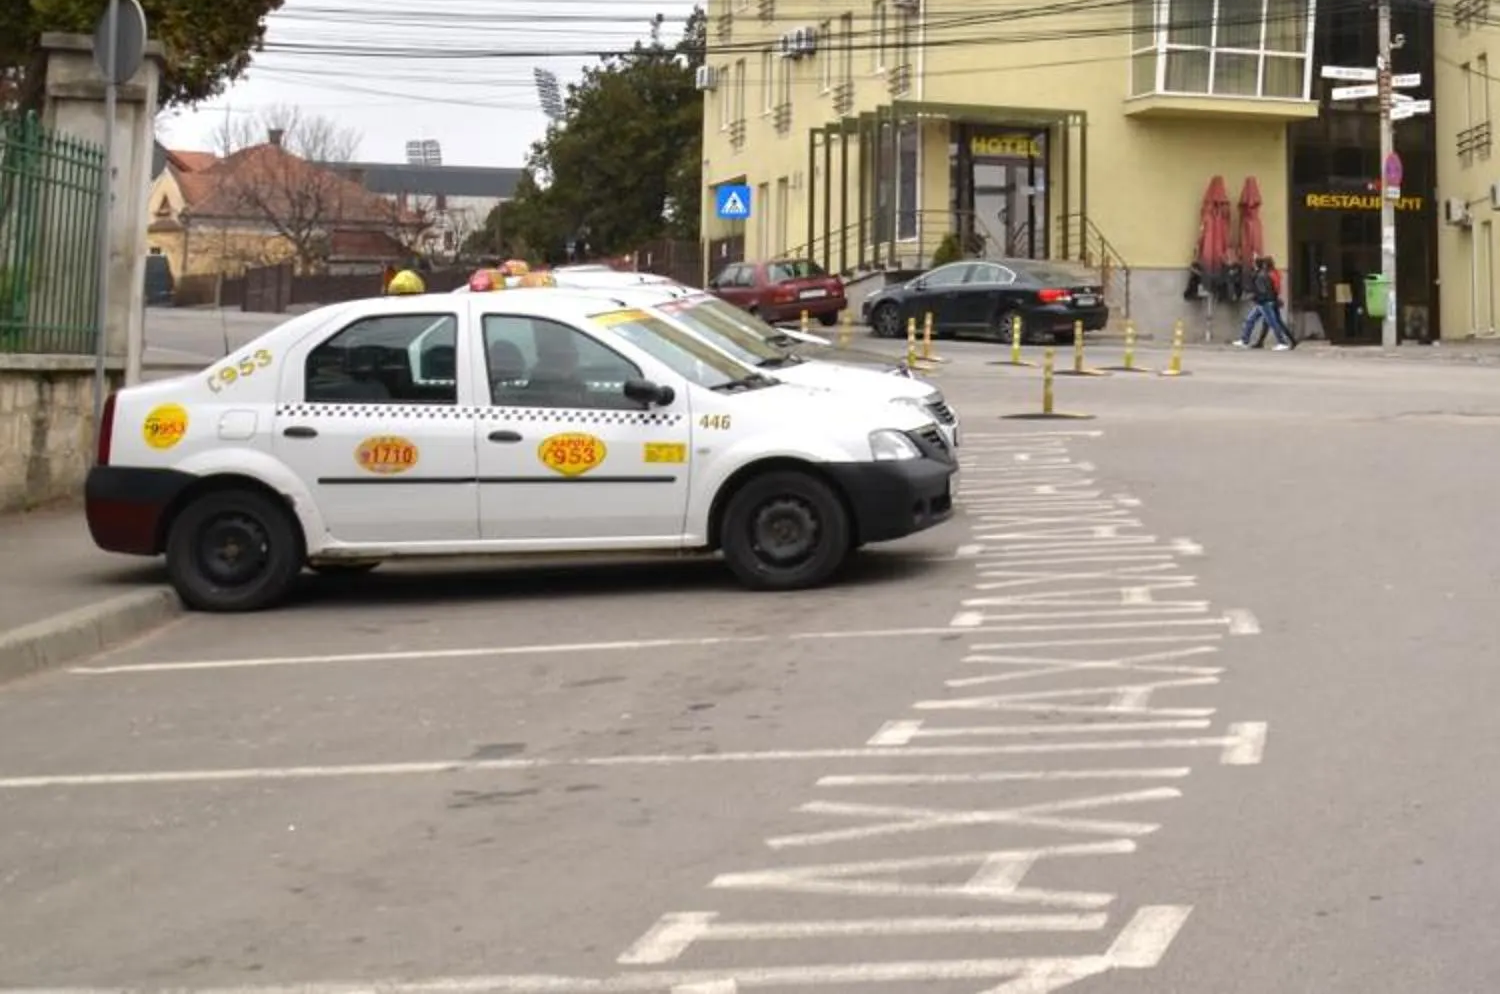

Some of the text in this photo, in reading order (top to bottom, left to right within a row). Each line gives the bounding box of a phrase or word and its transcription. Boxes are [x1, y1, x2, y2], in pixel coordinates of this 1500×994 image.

[971, 136, 1040, 157] HOTEL
[699, 414, 731, 430] 446
[373, 444, 412, 463] 1710
[552, 446, 596, 465] 953
